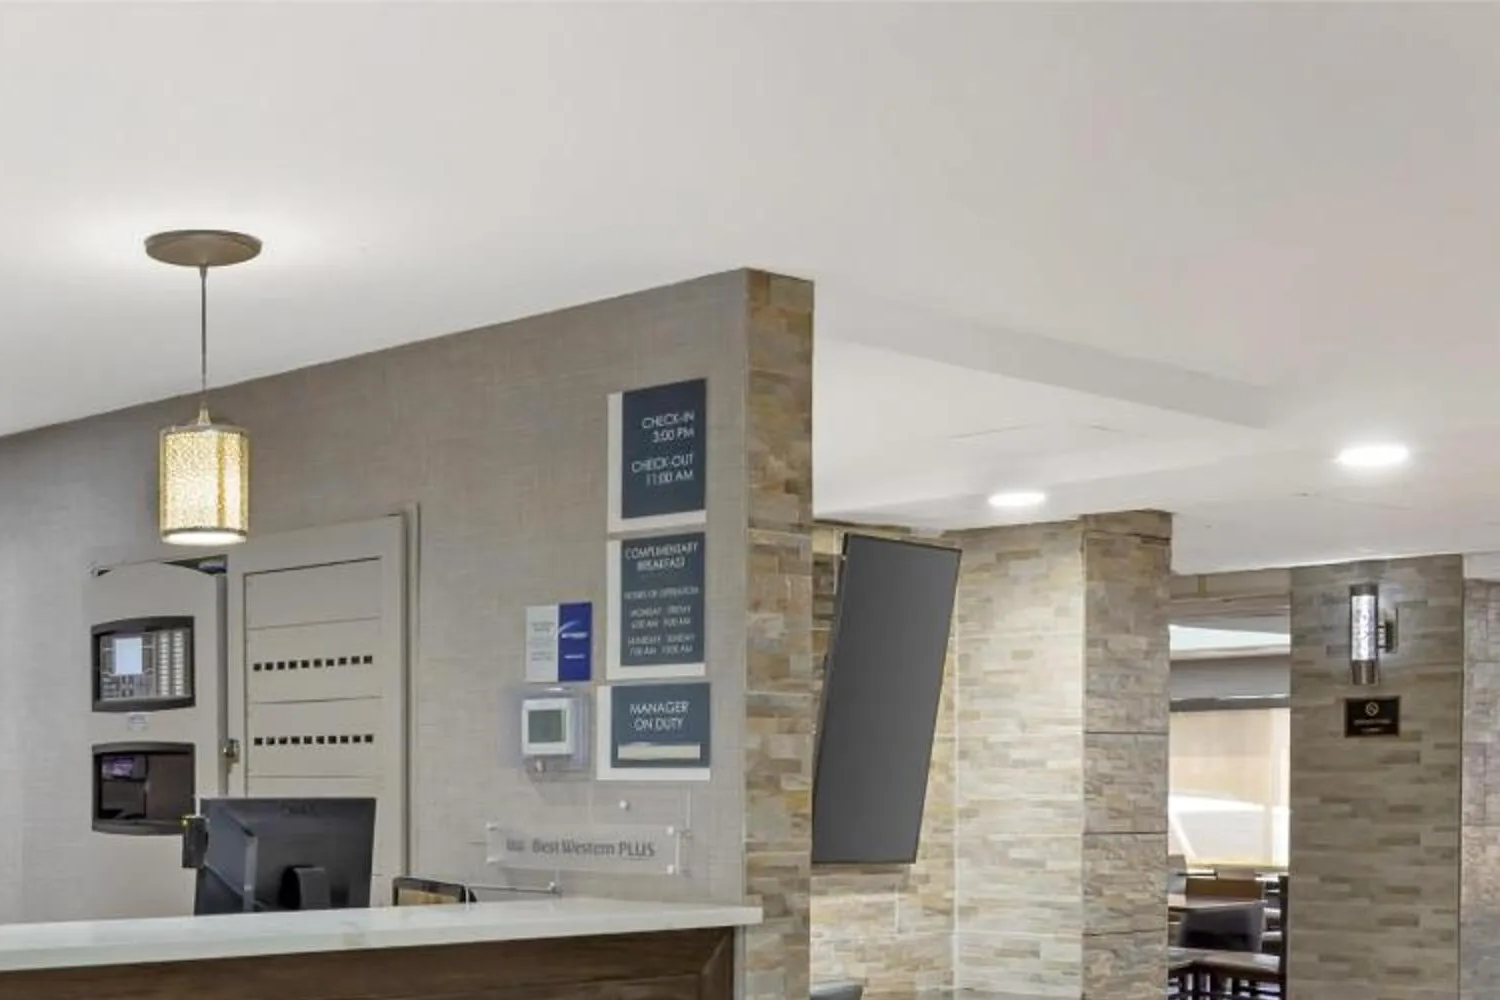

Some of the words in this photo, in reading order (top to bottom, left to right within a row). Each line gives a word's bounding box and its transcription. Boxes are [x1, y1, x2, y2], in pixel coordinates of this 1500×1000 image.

[642, 410, 695, 429] CHECK-IN
[652, 429, 675, 443] 3:00
[677, 426, 695, 440] PM
[646, 471, 673, 486] 11:00
[675, 468, 694, 481] AM
[629, 701, 689, 715] MANAGER
[634, 719, 653, 731] ON
[655, 717, 684, 731] DUTY
[532, 838, 559, 854] Best
[561, 839, 615, 855] Western
[618, 840, 655, 857] PLUS
